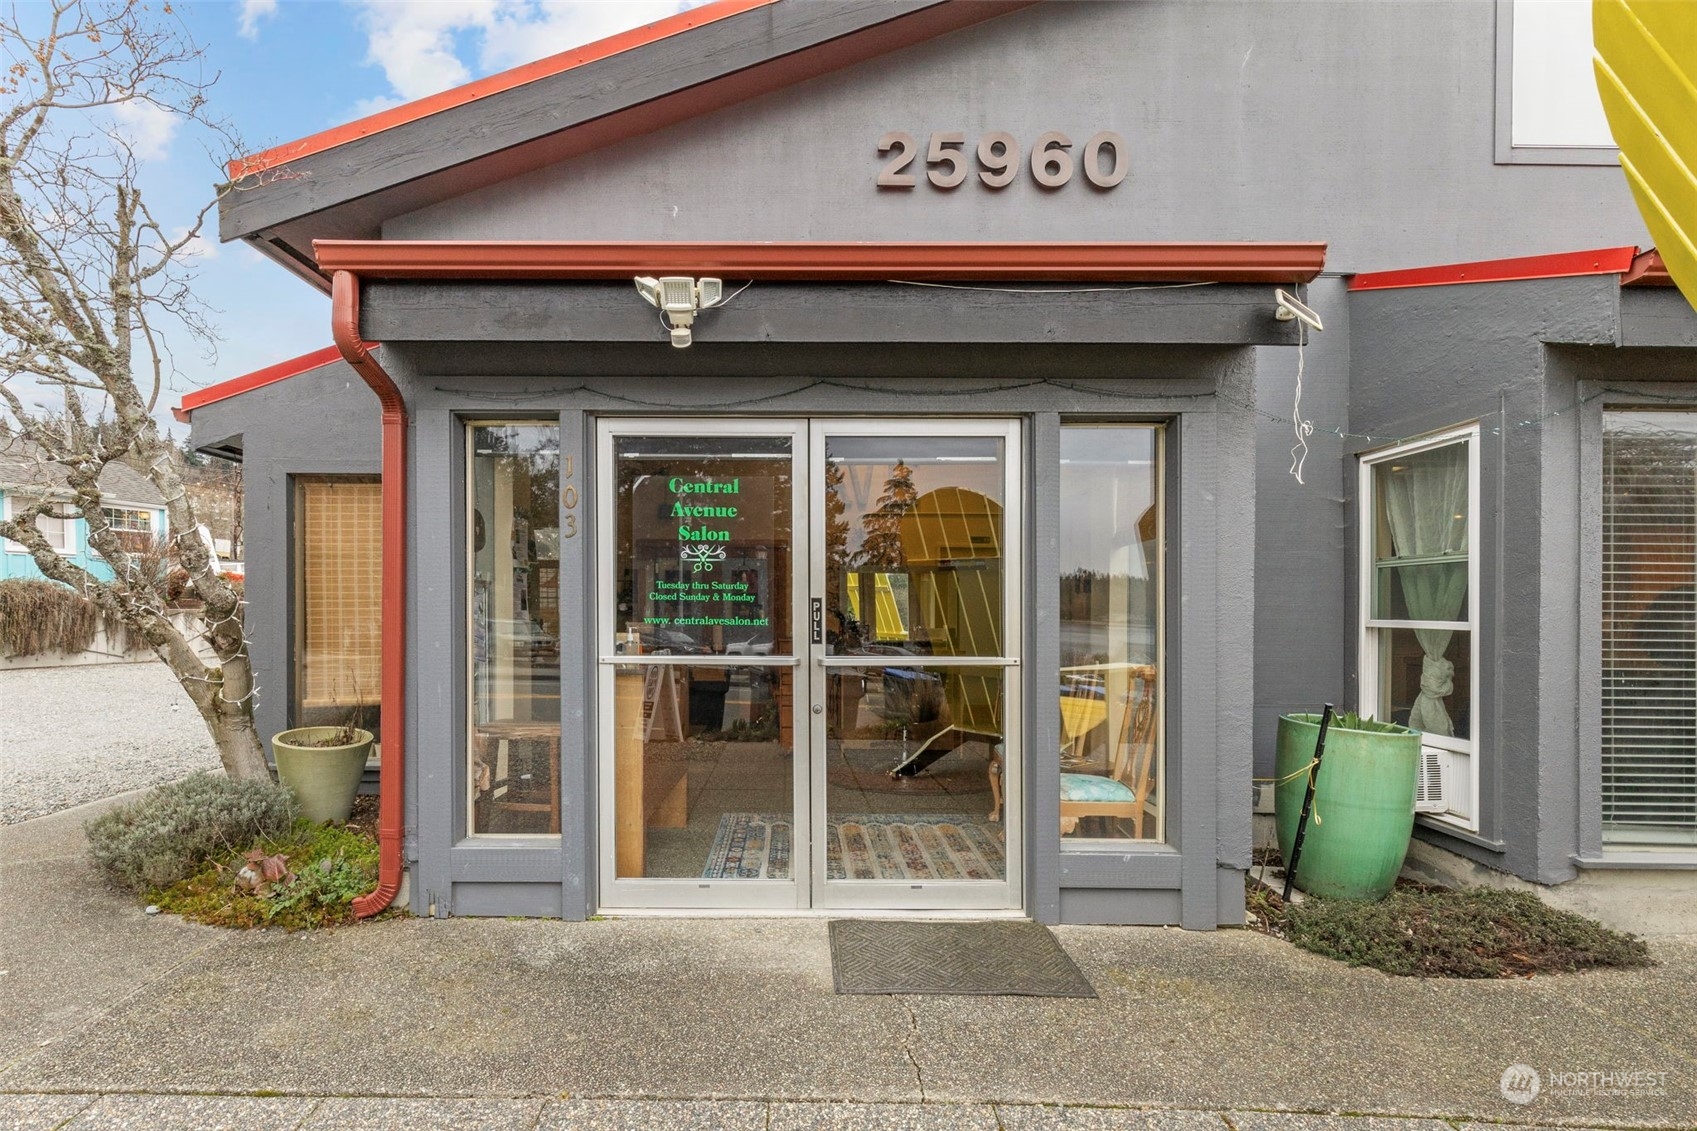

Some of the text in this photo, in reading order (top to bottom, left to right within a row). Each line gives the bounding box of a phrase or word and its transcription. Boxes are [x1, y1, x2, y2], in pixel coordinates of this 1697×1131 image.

[876, 130, 1129, 190] 25960
[668, 477, 740, 494] Central
[671, 501, 737, 518] Avenue
[677, 524, 730, 541] Salon
[656, 580, 749, 592] Tuesday thru Saturday
[649, 592, 756, 603] Closed Sunday & Monday
